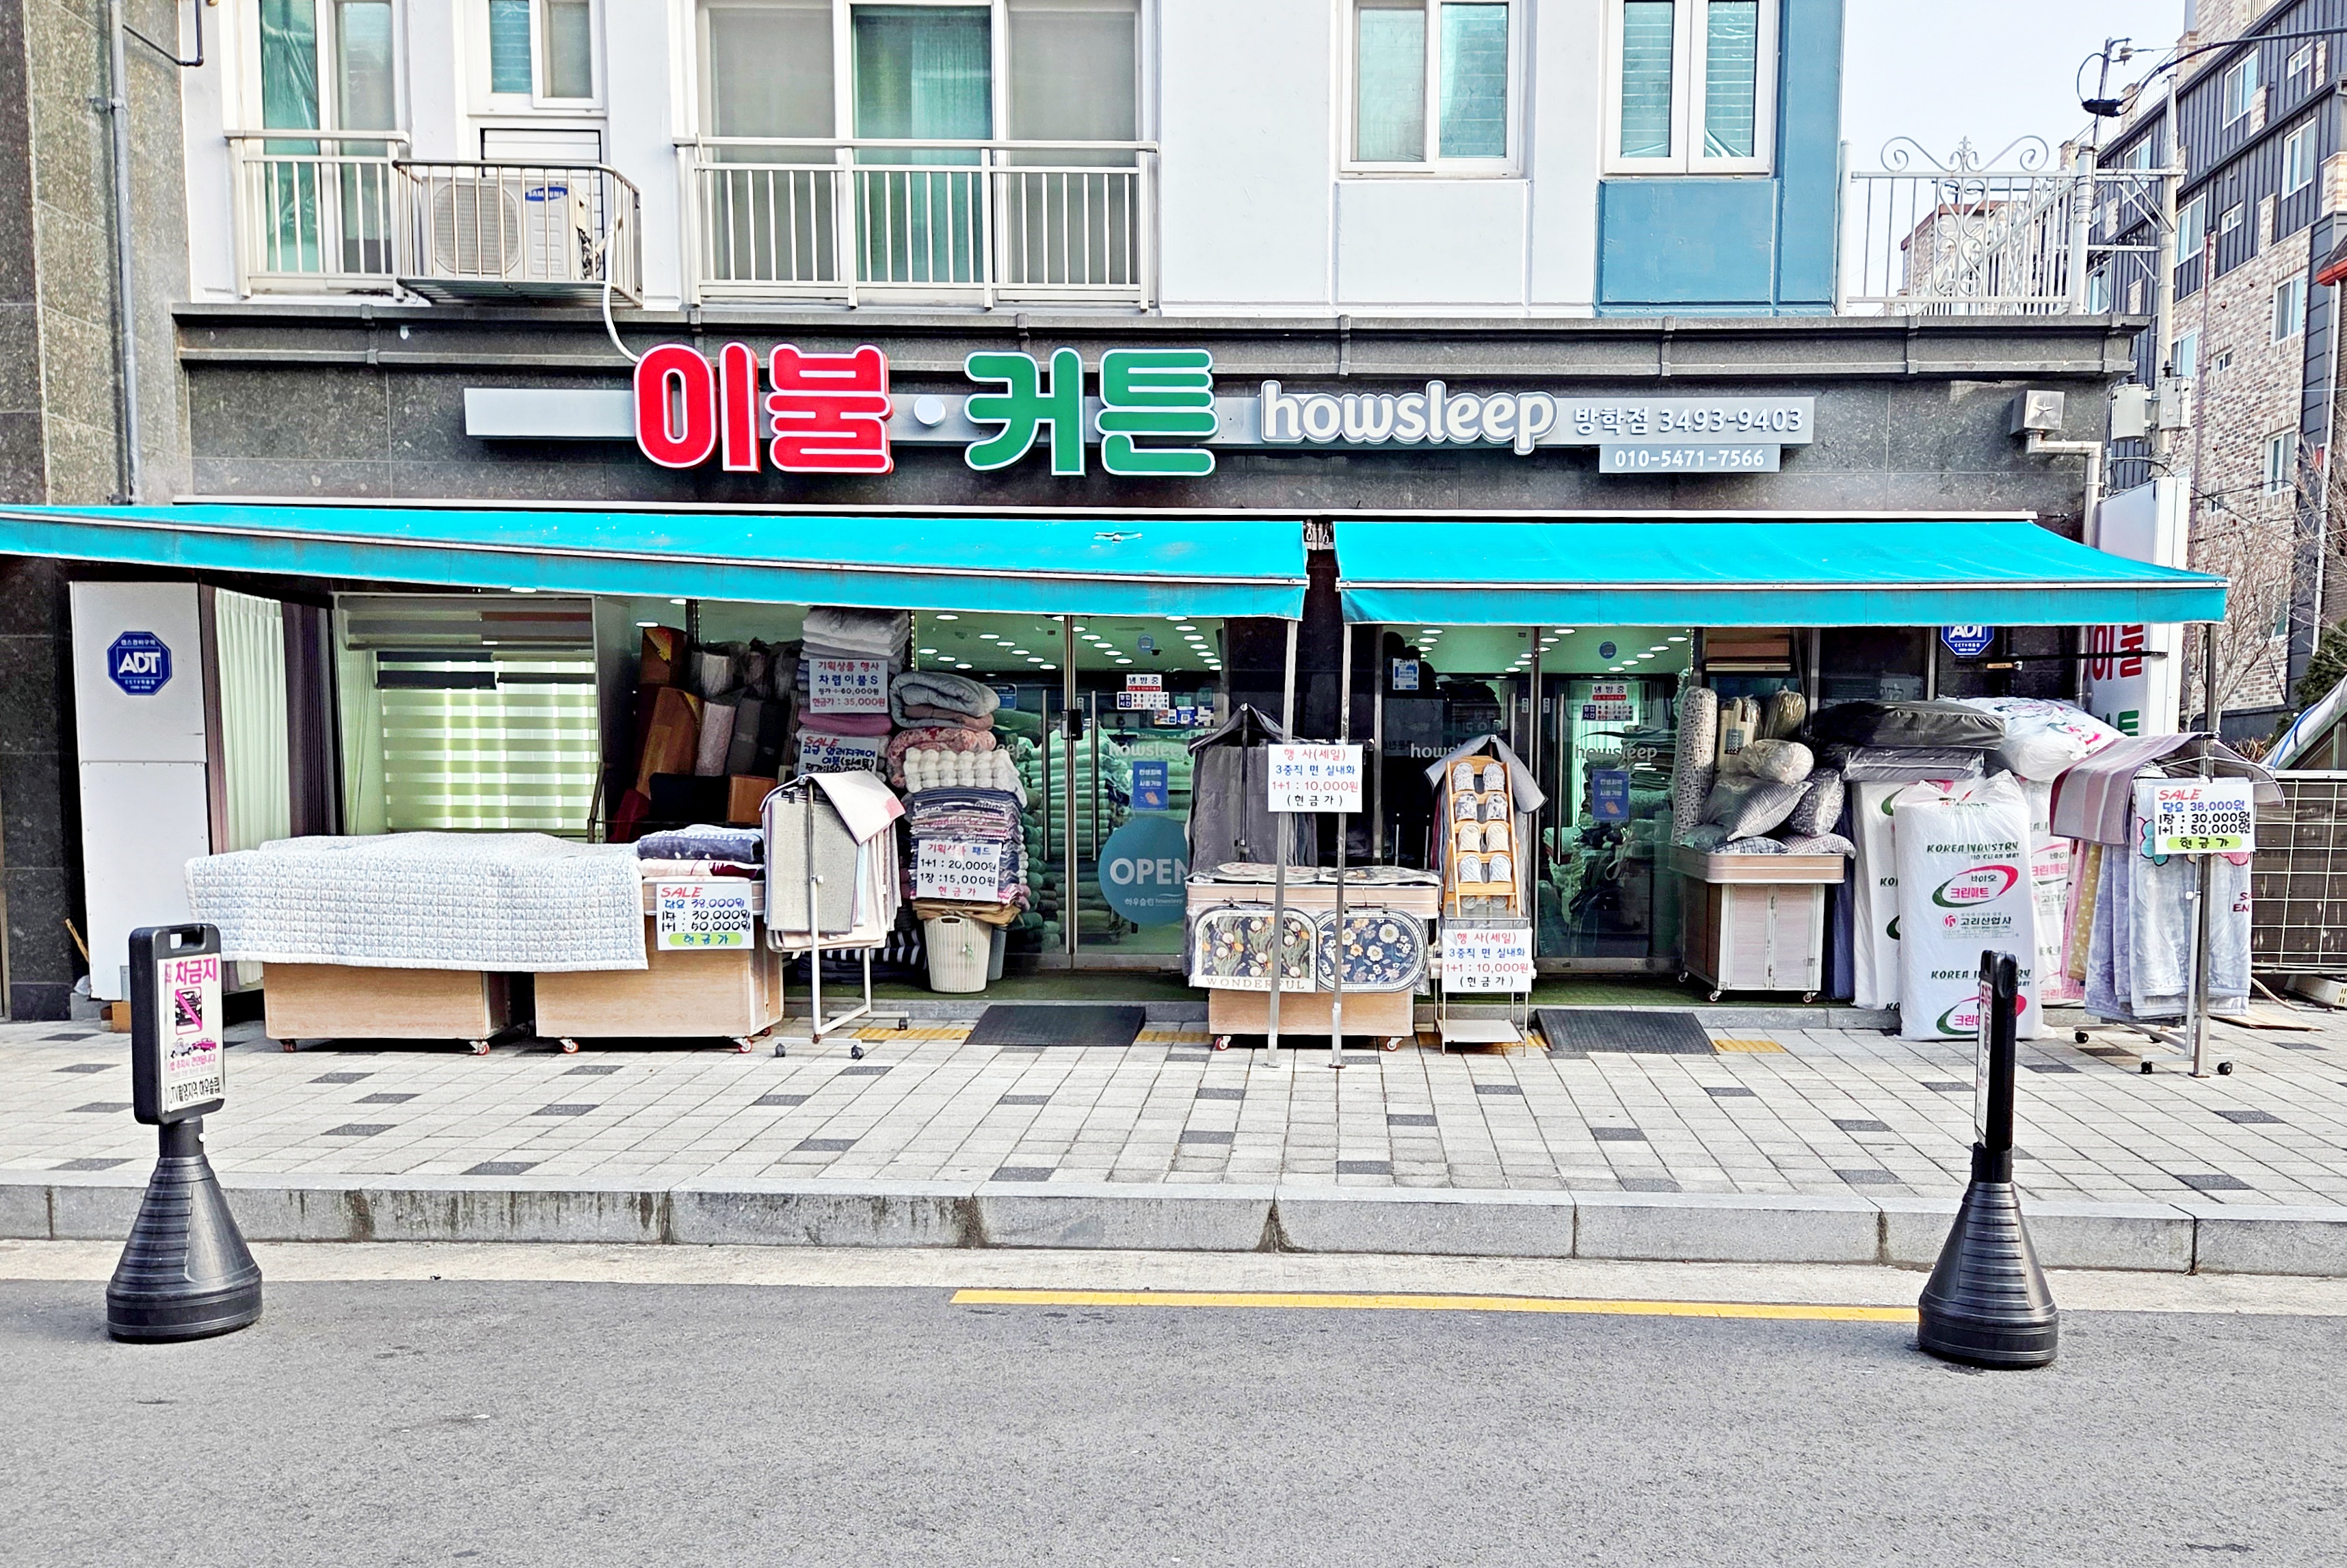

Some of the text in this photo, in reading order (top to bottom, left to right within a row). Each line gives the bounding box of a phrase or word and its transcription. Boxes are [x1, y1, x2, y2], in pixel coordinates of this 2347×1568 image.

[633, 342, 1219, 477] 이불 커튼
[1260, 380, 1559, 455] howsleep
[1574, 406, 1804, 436] 방학점 3493-9403
[1615, 448, 1765, 469] 010-5471-7566
[118, 652, 161, 674] ADT
[818, 661, 879, 672] 기획상품 행사
[844, 697, 885, 707] 35,000원
[805, 736, 840, 747] SALE
[803, 745, 820, 755] 고급
[1276, 765, 1355, 776] 3중직 면 실내화
[1272, 781, 1290, 790] 1+1
[1305, 781, 1358, 793] 10,000원
[2159, 788, 2202, 801] SALE
[2163, 799, 2245, 812] 담요 38,000원
[2160, 814, 2175, 825] 1장
[2192, 811, 2250, 824] 30,000원
[2159, 825, 2173, 835] 1+1
[2191, 822, 2251, 835] 50,000원
[972, 847, 991, 855] 패드
[1927, 843, 1964, 853] KOREA
[920, 858, 936, 867] 1+1
[949, 860, 996, 873] 20,000원
[920, 873, 934, 883] 1장
[661, 887, 703, 898] SALE
[1950, 887, 1989, 899] 크린매트
[665, 899, 685, 909] 담요
[1124, 898, 1154, 906] 하우슬립
[662, 910, 676, 921] 1장
[1960, 916, 2012, 925] 고리산업사
[662, 922, 676, 932] 1+1
[1449, 948, 1526, 959] 3중직 면 실내화
[1446, 964, 1463, 972] 1+1
[1477, 963, 1528, 974] 10,000원
[1931, 970, 1969, 979] KOREA
[1206, 978, 1305, 989] WONDERUL
[1954, 1015, 1980, 1026] 크린
[199, 1076, 220, 1096] 하우슬립
